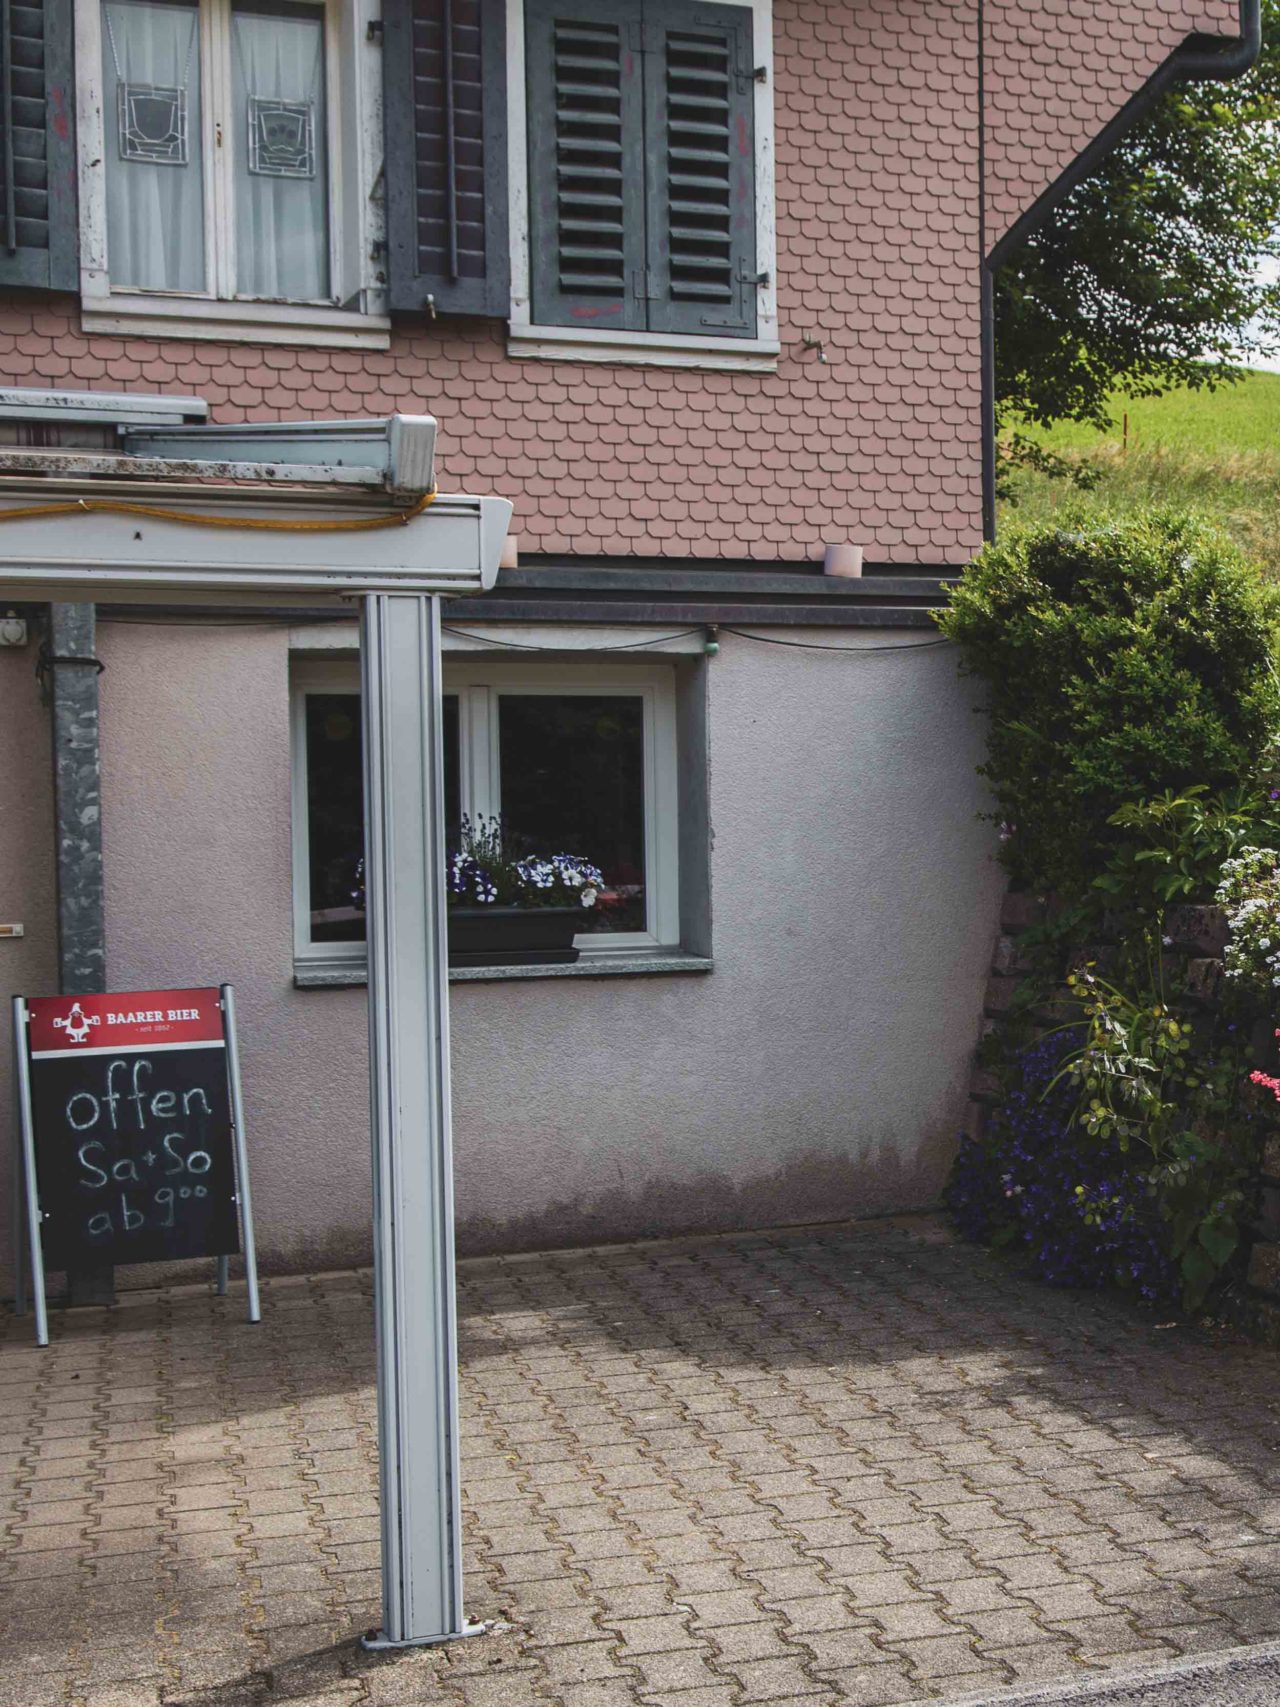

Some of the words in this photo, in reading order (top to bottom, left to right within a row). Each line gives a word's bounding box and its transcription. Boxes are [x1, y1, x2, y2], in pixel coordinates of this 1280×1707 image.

[106, 1010, 164, 1024] BAARER
[167, 1008, 200, 1021] BIER
[88, 1193, 145, 1234] ab
